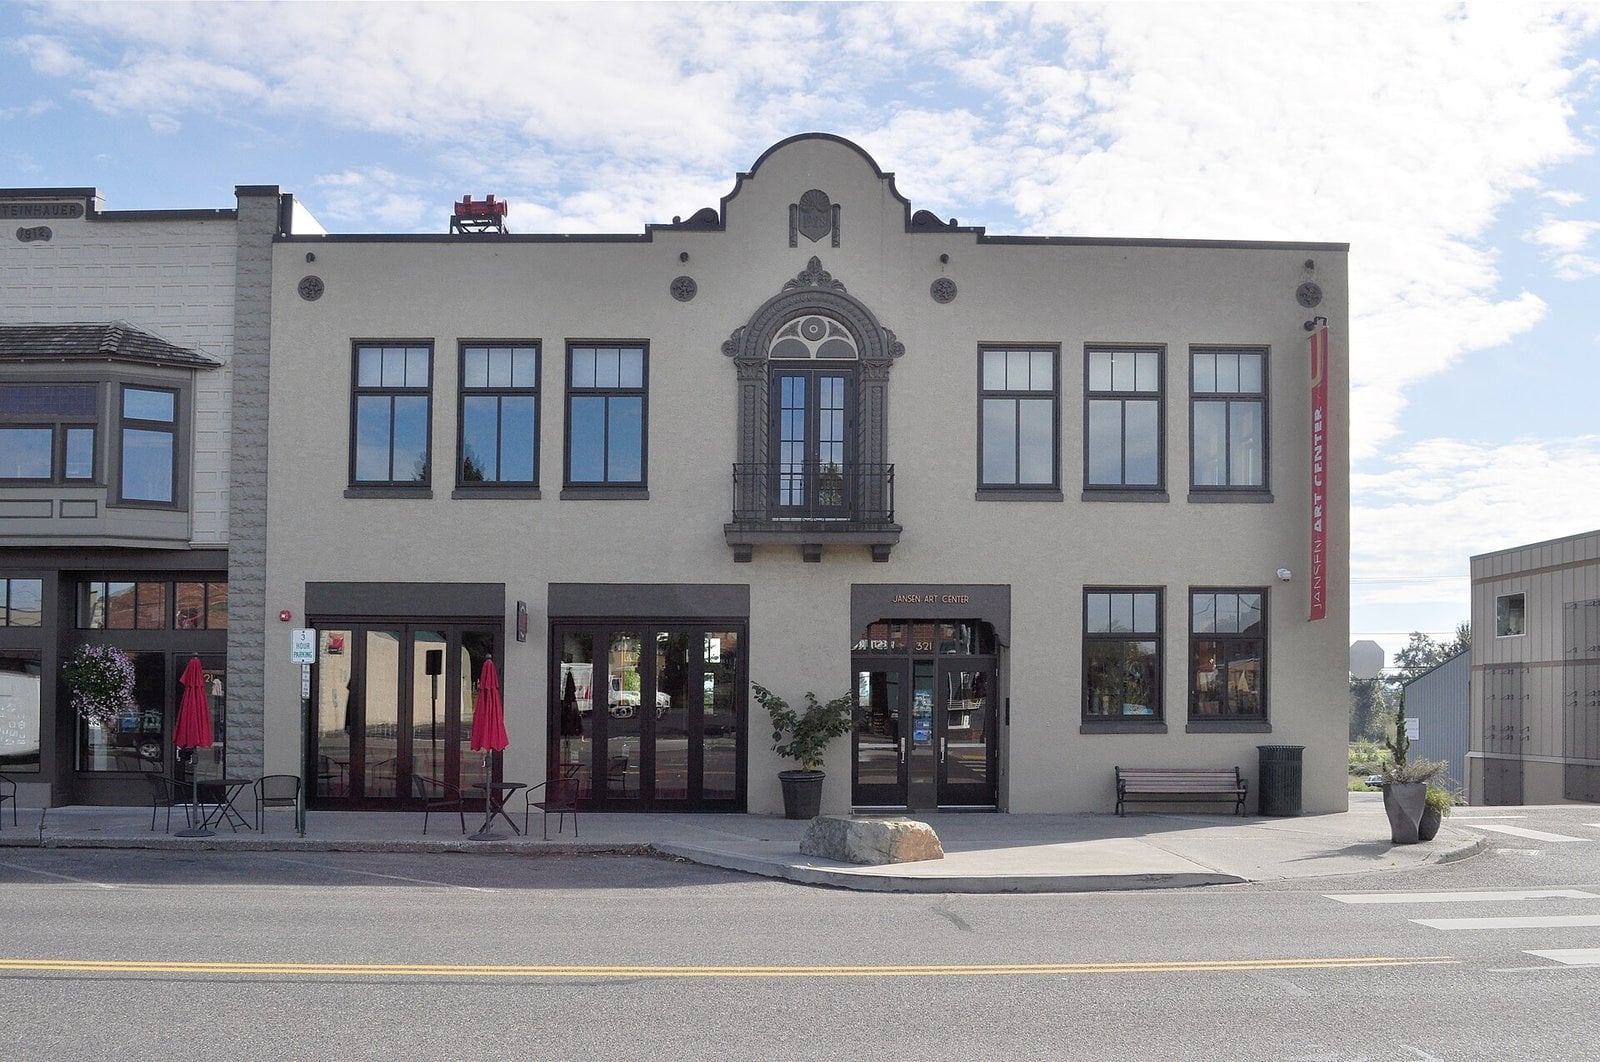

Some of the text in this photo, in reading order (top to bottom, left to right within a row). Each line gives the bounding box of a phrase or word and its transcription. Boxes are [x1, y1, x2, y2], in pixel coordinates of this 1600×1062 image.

[1314, 406, 1322, 487] CENTER
[1314, 493, 1322, 532] ART
[892, 594, 969, 603] JANSEN ART CENTER
[300, 633, 306, 641] 3
[296, 642, 310, 650] HOUR
[915, 641, 932, 651] 321
[293, 651, 312, 659] PARKING
